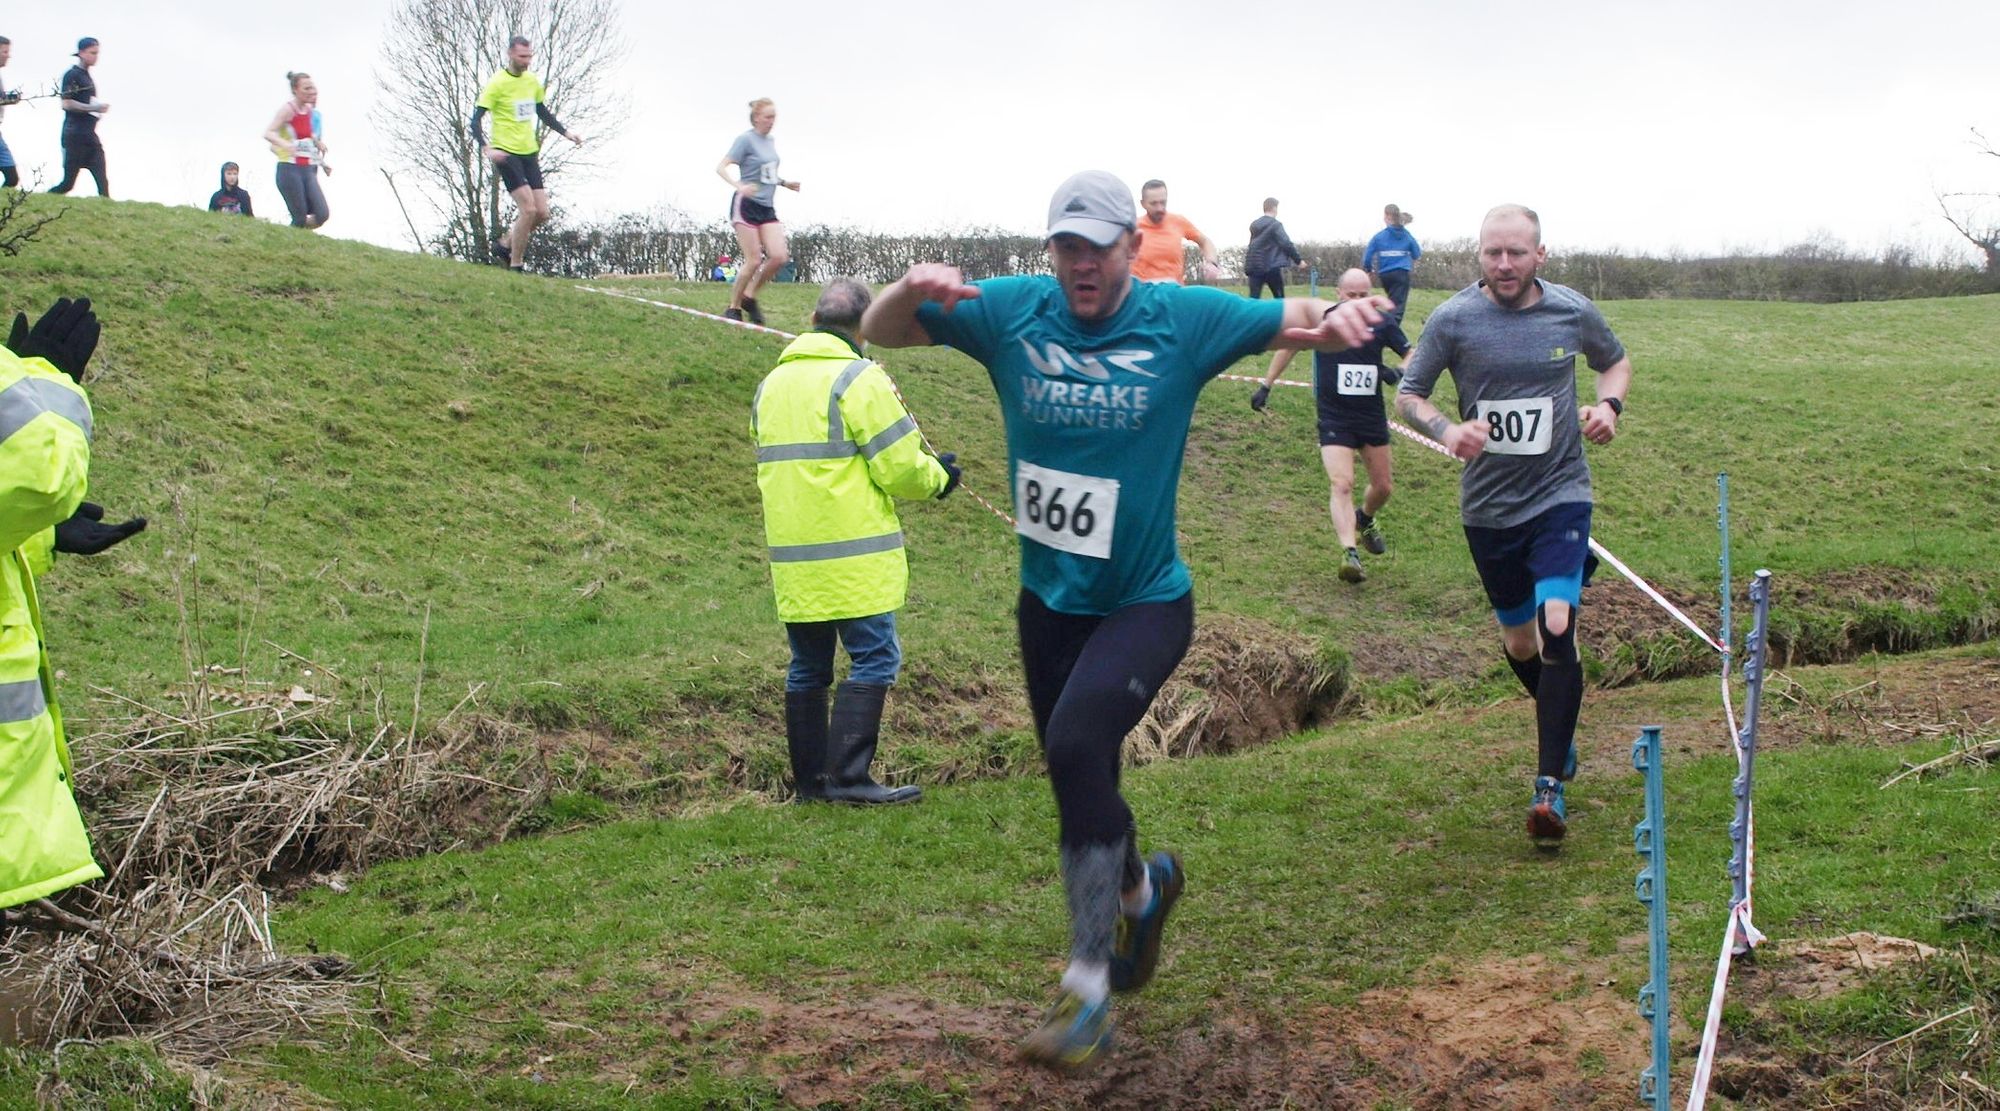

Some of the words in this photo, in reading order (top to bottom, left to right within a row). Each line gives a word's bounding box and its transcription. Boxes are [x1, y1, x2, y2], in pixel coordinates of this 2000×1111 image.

[1022, 376, 1149, 410] WREAKE
[1344, 371, 1372, 388] 826
[1022, 401, 1144, 430] RUNNERS
[1487, 409, 1542, 443] 807
[1026, 480, 1094, 537] 866
